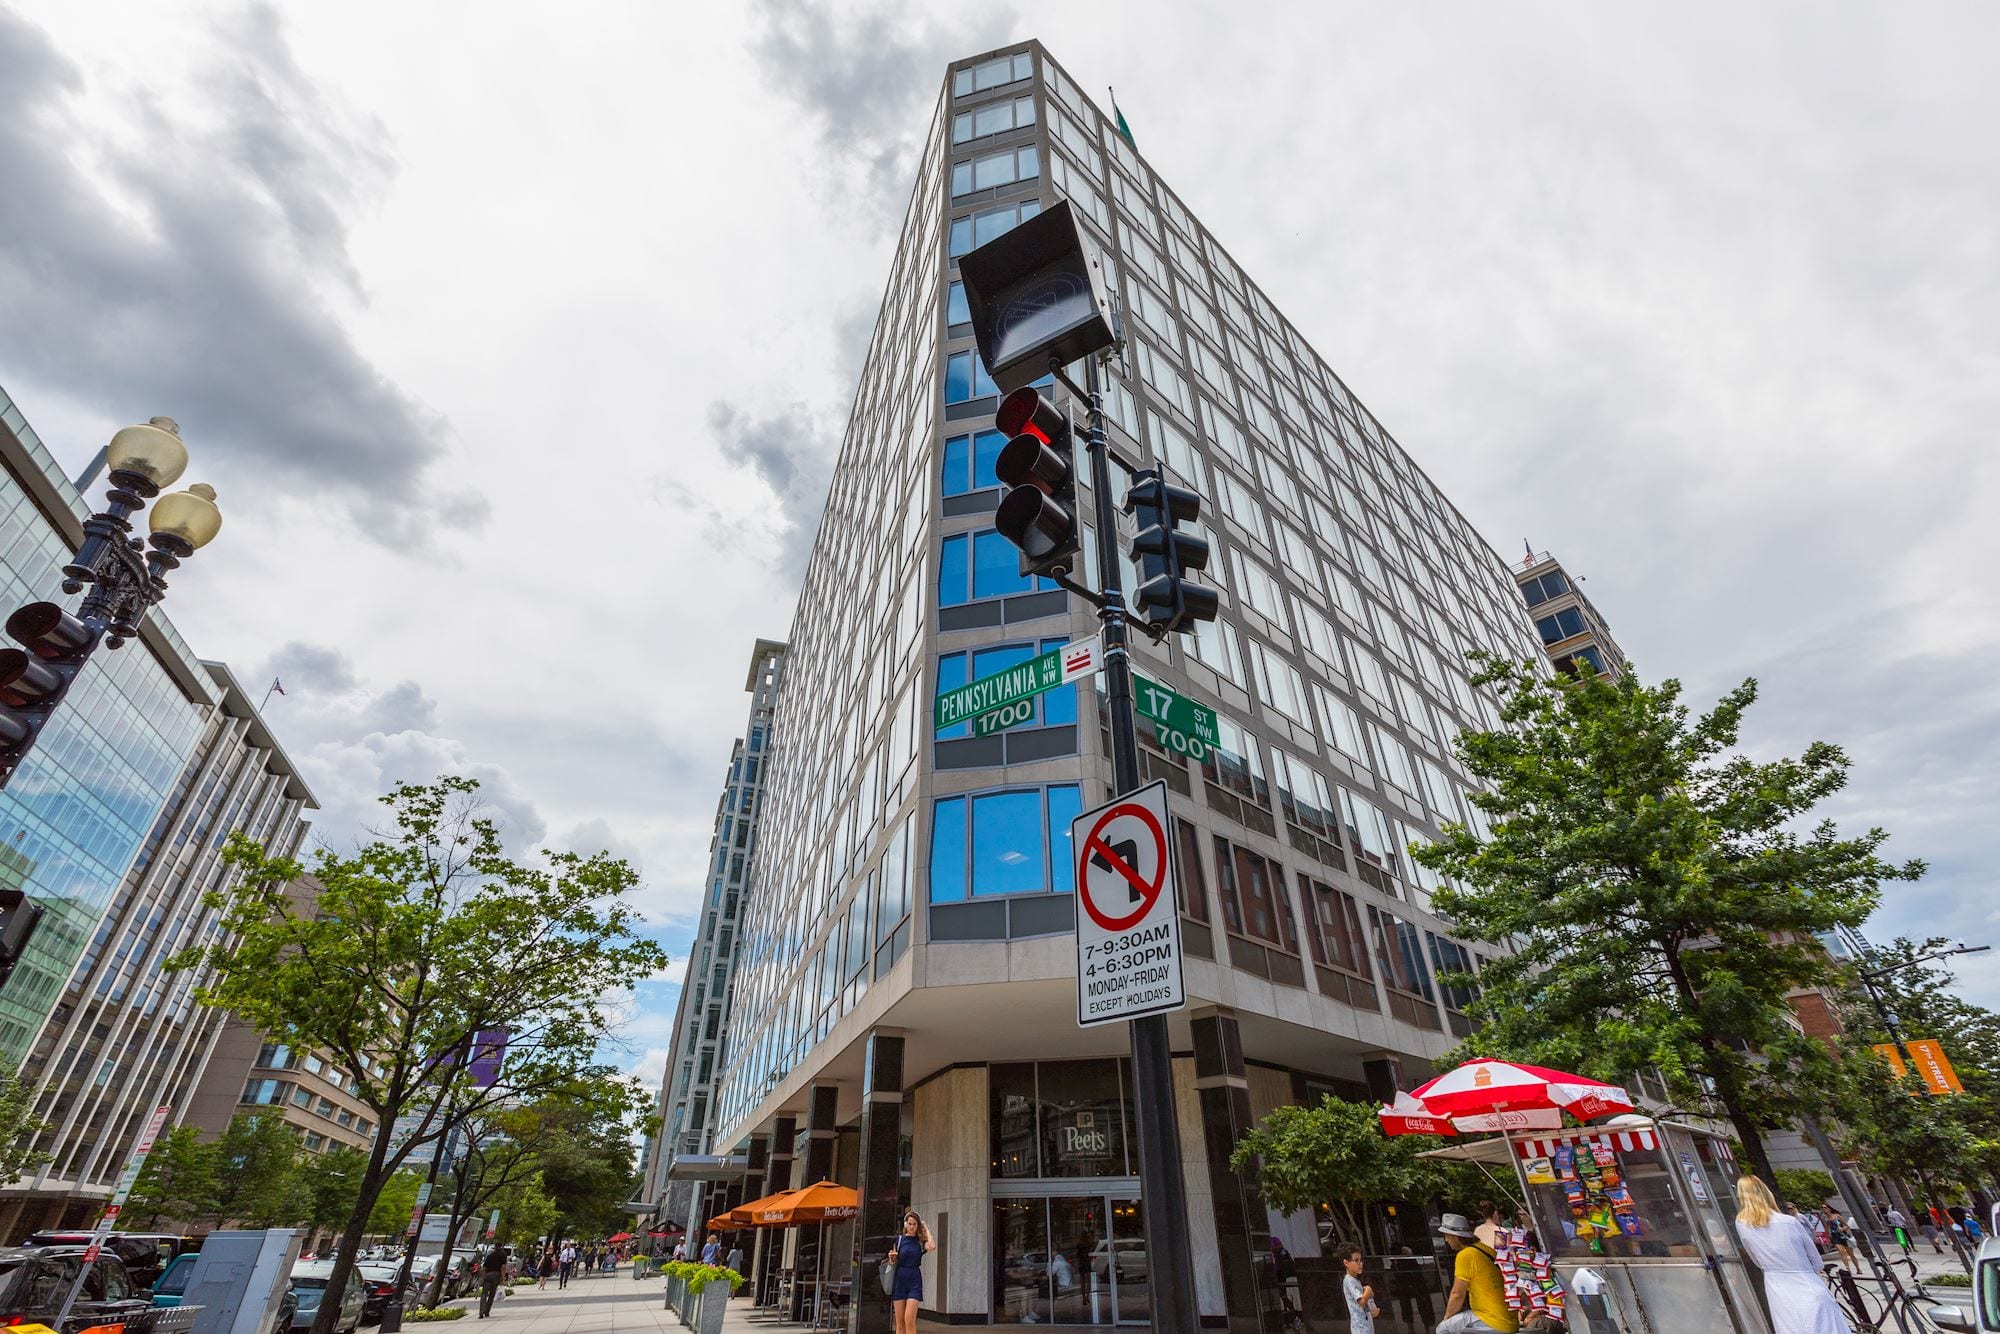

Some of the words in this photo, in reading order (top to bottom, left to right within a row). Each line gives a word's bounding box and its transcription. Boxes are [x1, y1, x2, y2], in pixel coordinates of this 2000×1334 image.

[1043, 655, 1055, 671] AVE
[1043, 670, 1056, 686] NW
[941, 665, 1037, 723] PENNSYLVANIA
[1144, 687, 1173, 720] 17
[978, 700, 1031, 734] 1700
[1194, 709, 1208, 723] ST
[1195, 723, 1213, 740] NW
[1157, 725, 1205, 759] 700
[1085, 924, 1170, 960] 7-9:30AM
[1086, 943, 1171, 978] 4-6:30PM
[1088, 964, 1170, 997] MONDAY-FRIDAY
[1089, 997, 1123, 1014] EXCEPT
[1126, 986, 1171, 1006] HOLIDAYS
[1927, 1060, 1949, 1089] STREET
[1063, 1126, 1105, 1151] Peet's
